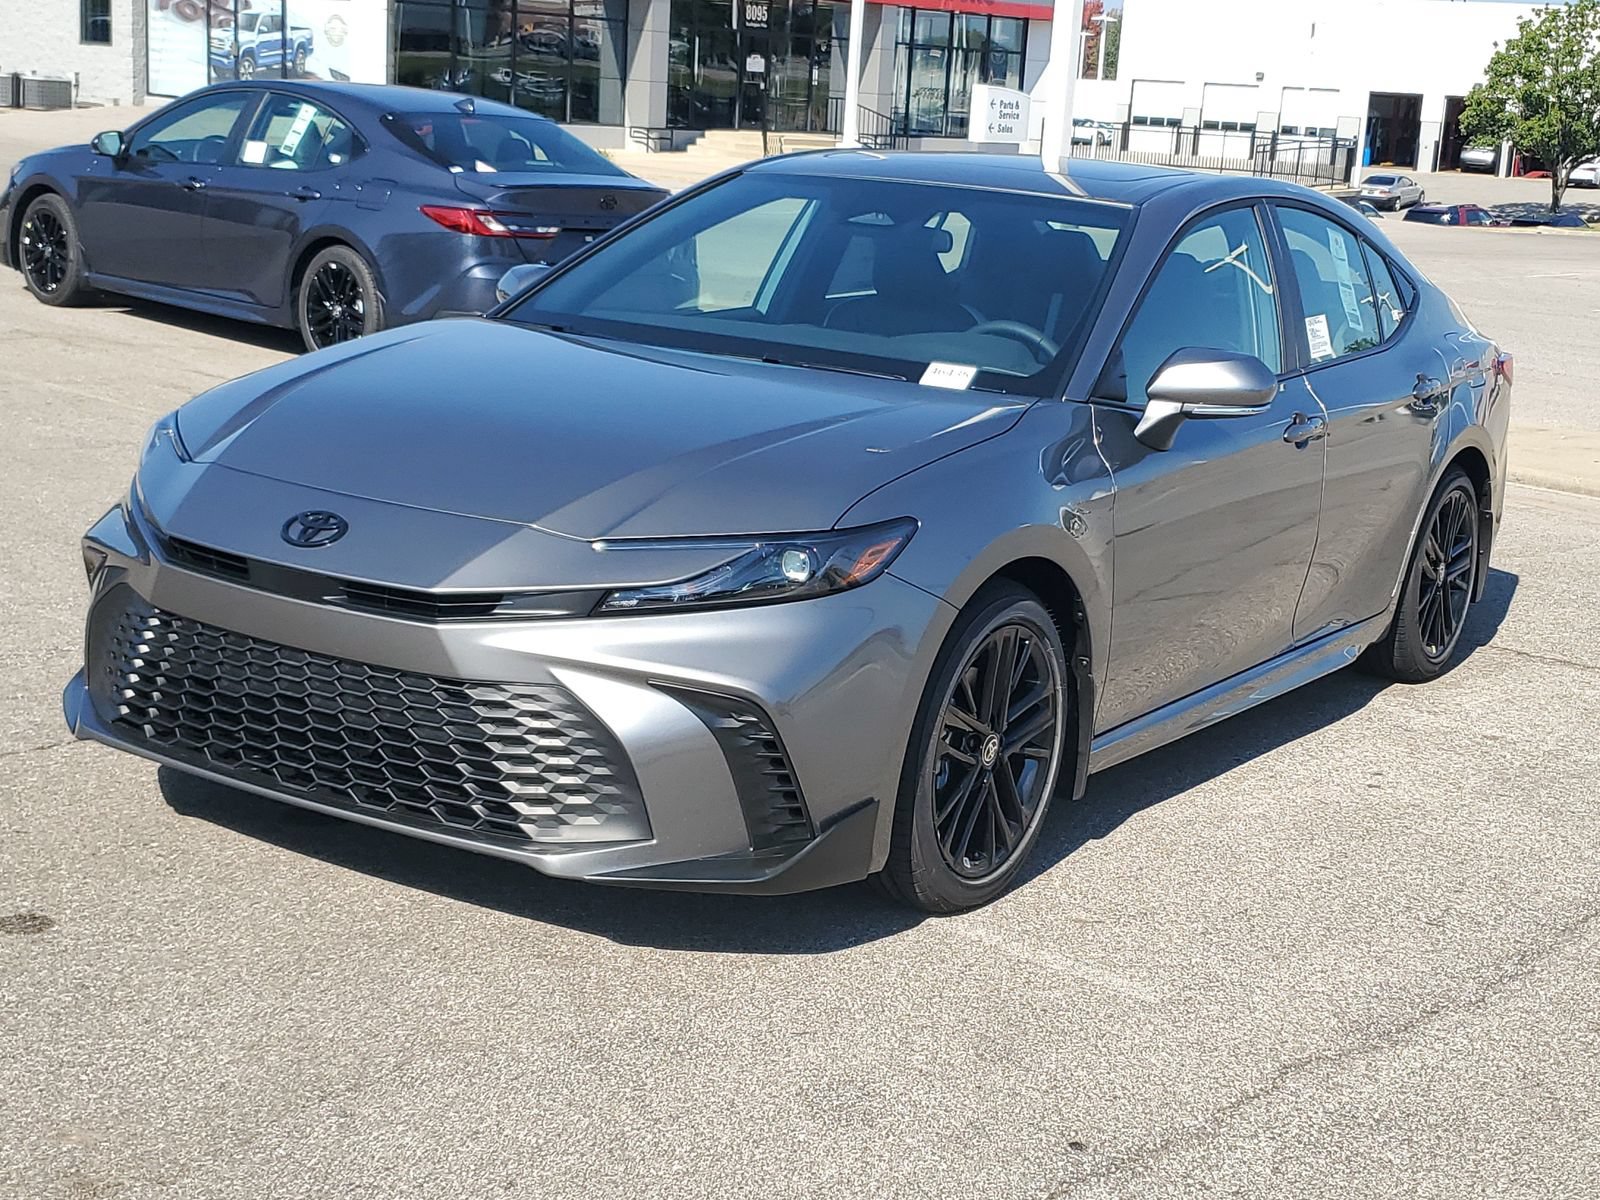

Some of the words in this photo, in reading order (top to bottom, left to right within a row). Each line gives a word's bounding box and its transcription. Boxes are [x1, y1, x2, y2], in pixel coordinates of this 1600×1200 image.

[745, 4, 768, 21] 8095
[999, 99, 1014, 110] Parts
[1014, 100, 1020, 110] &
[998, 110, 1020, 120] Service
[997, 123, 1013, 133] Sales
